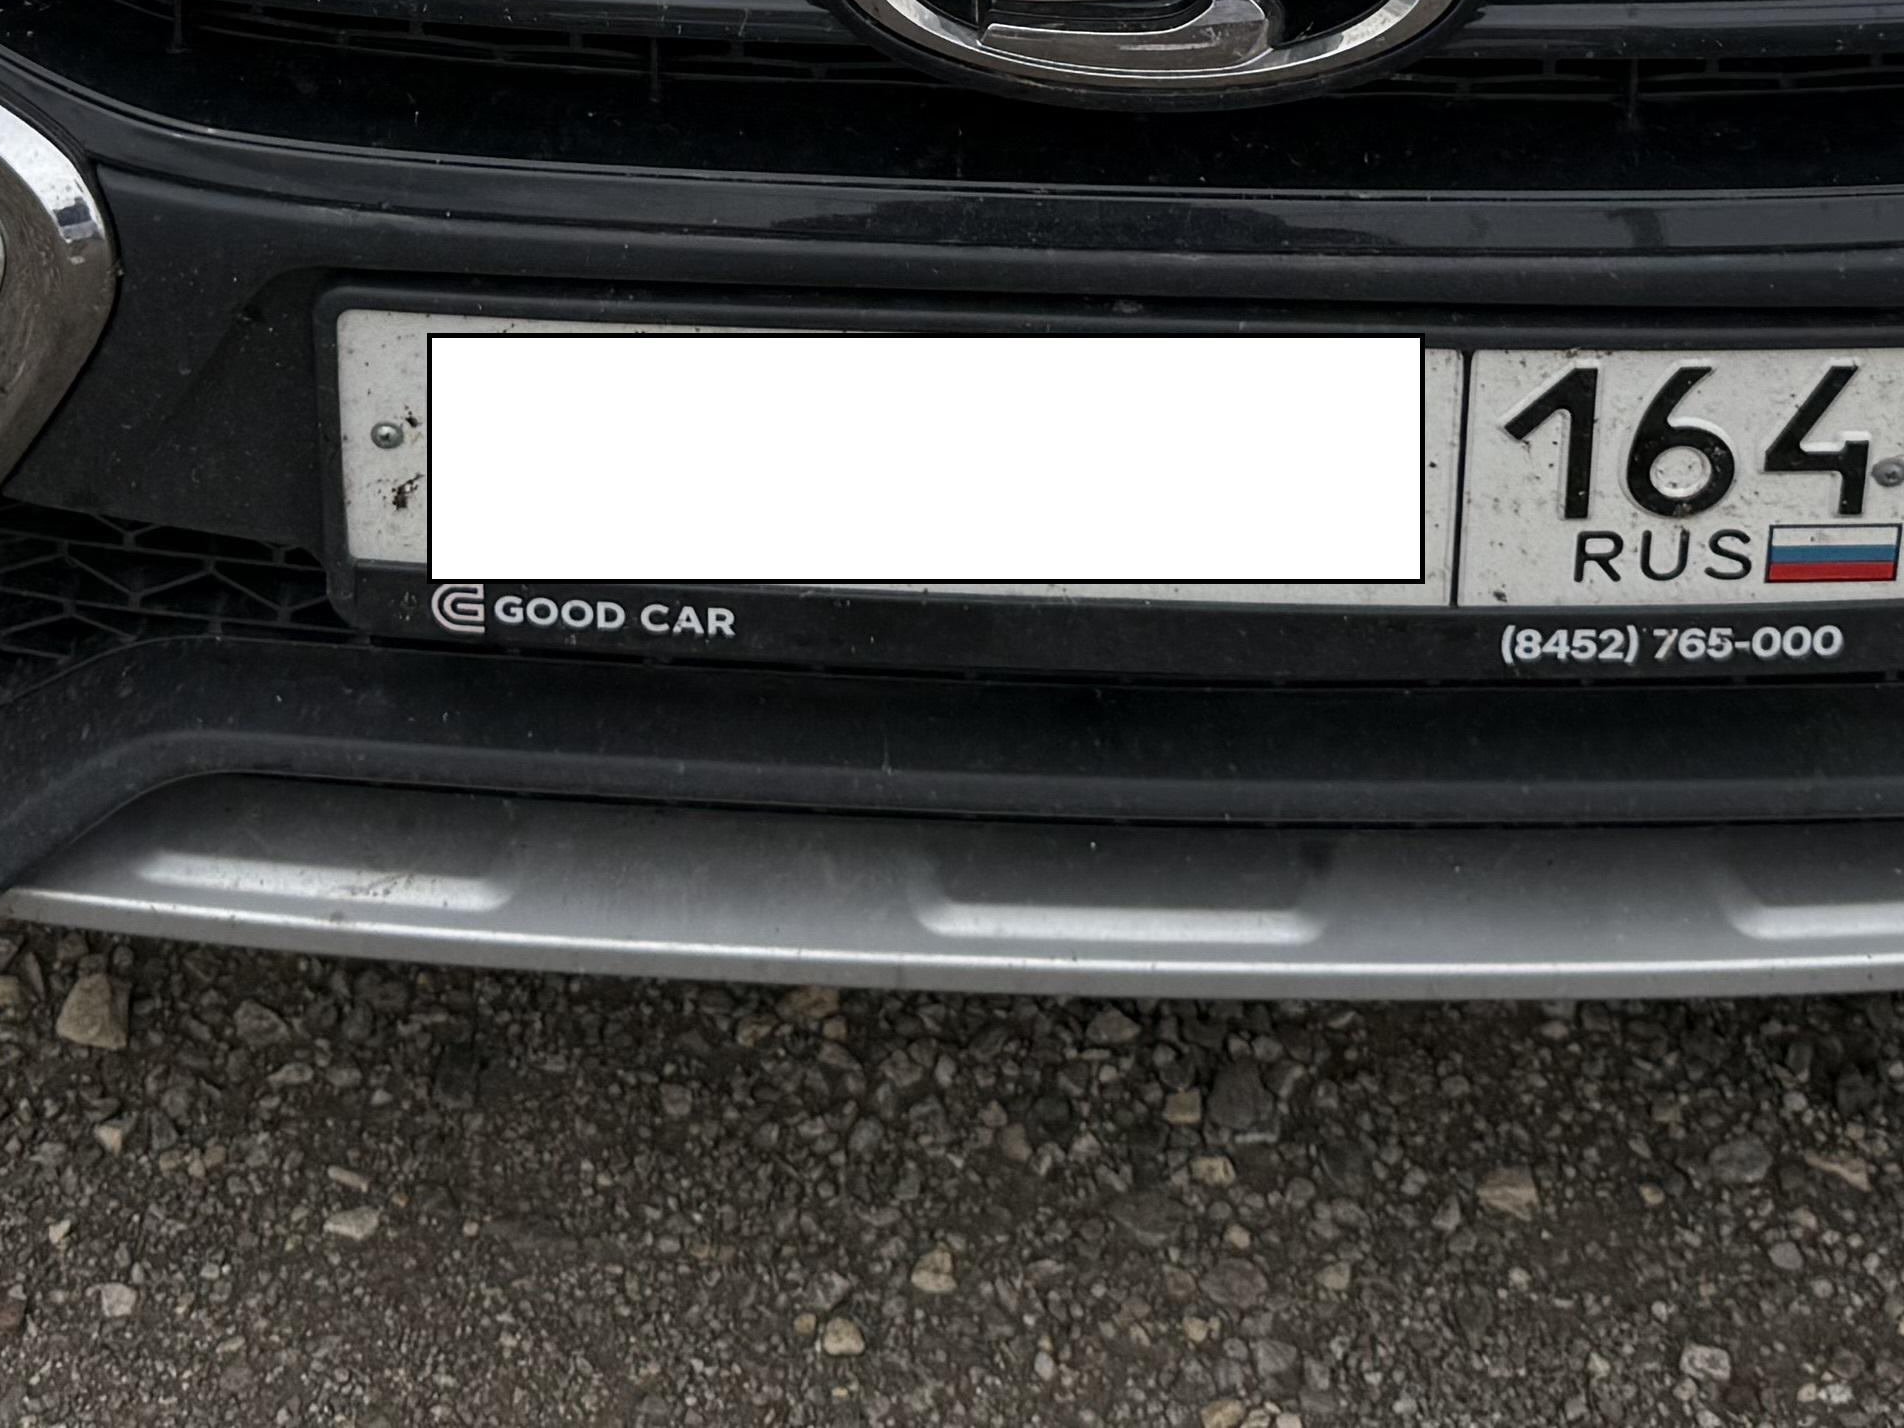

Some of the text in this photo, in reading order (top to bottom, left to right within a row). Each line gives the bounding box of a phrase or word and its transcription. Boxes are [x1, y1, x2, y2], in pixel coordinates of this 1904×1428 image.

[1503, 365, 1870, 519] 164
[1574, 529, 1753, 583] RUS
[494, 596, 626, 629] GOOD
[641, 604, 736, 636] CAR
[1501, 624, 1843, 664] (8452) 765-000
